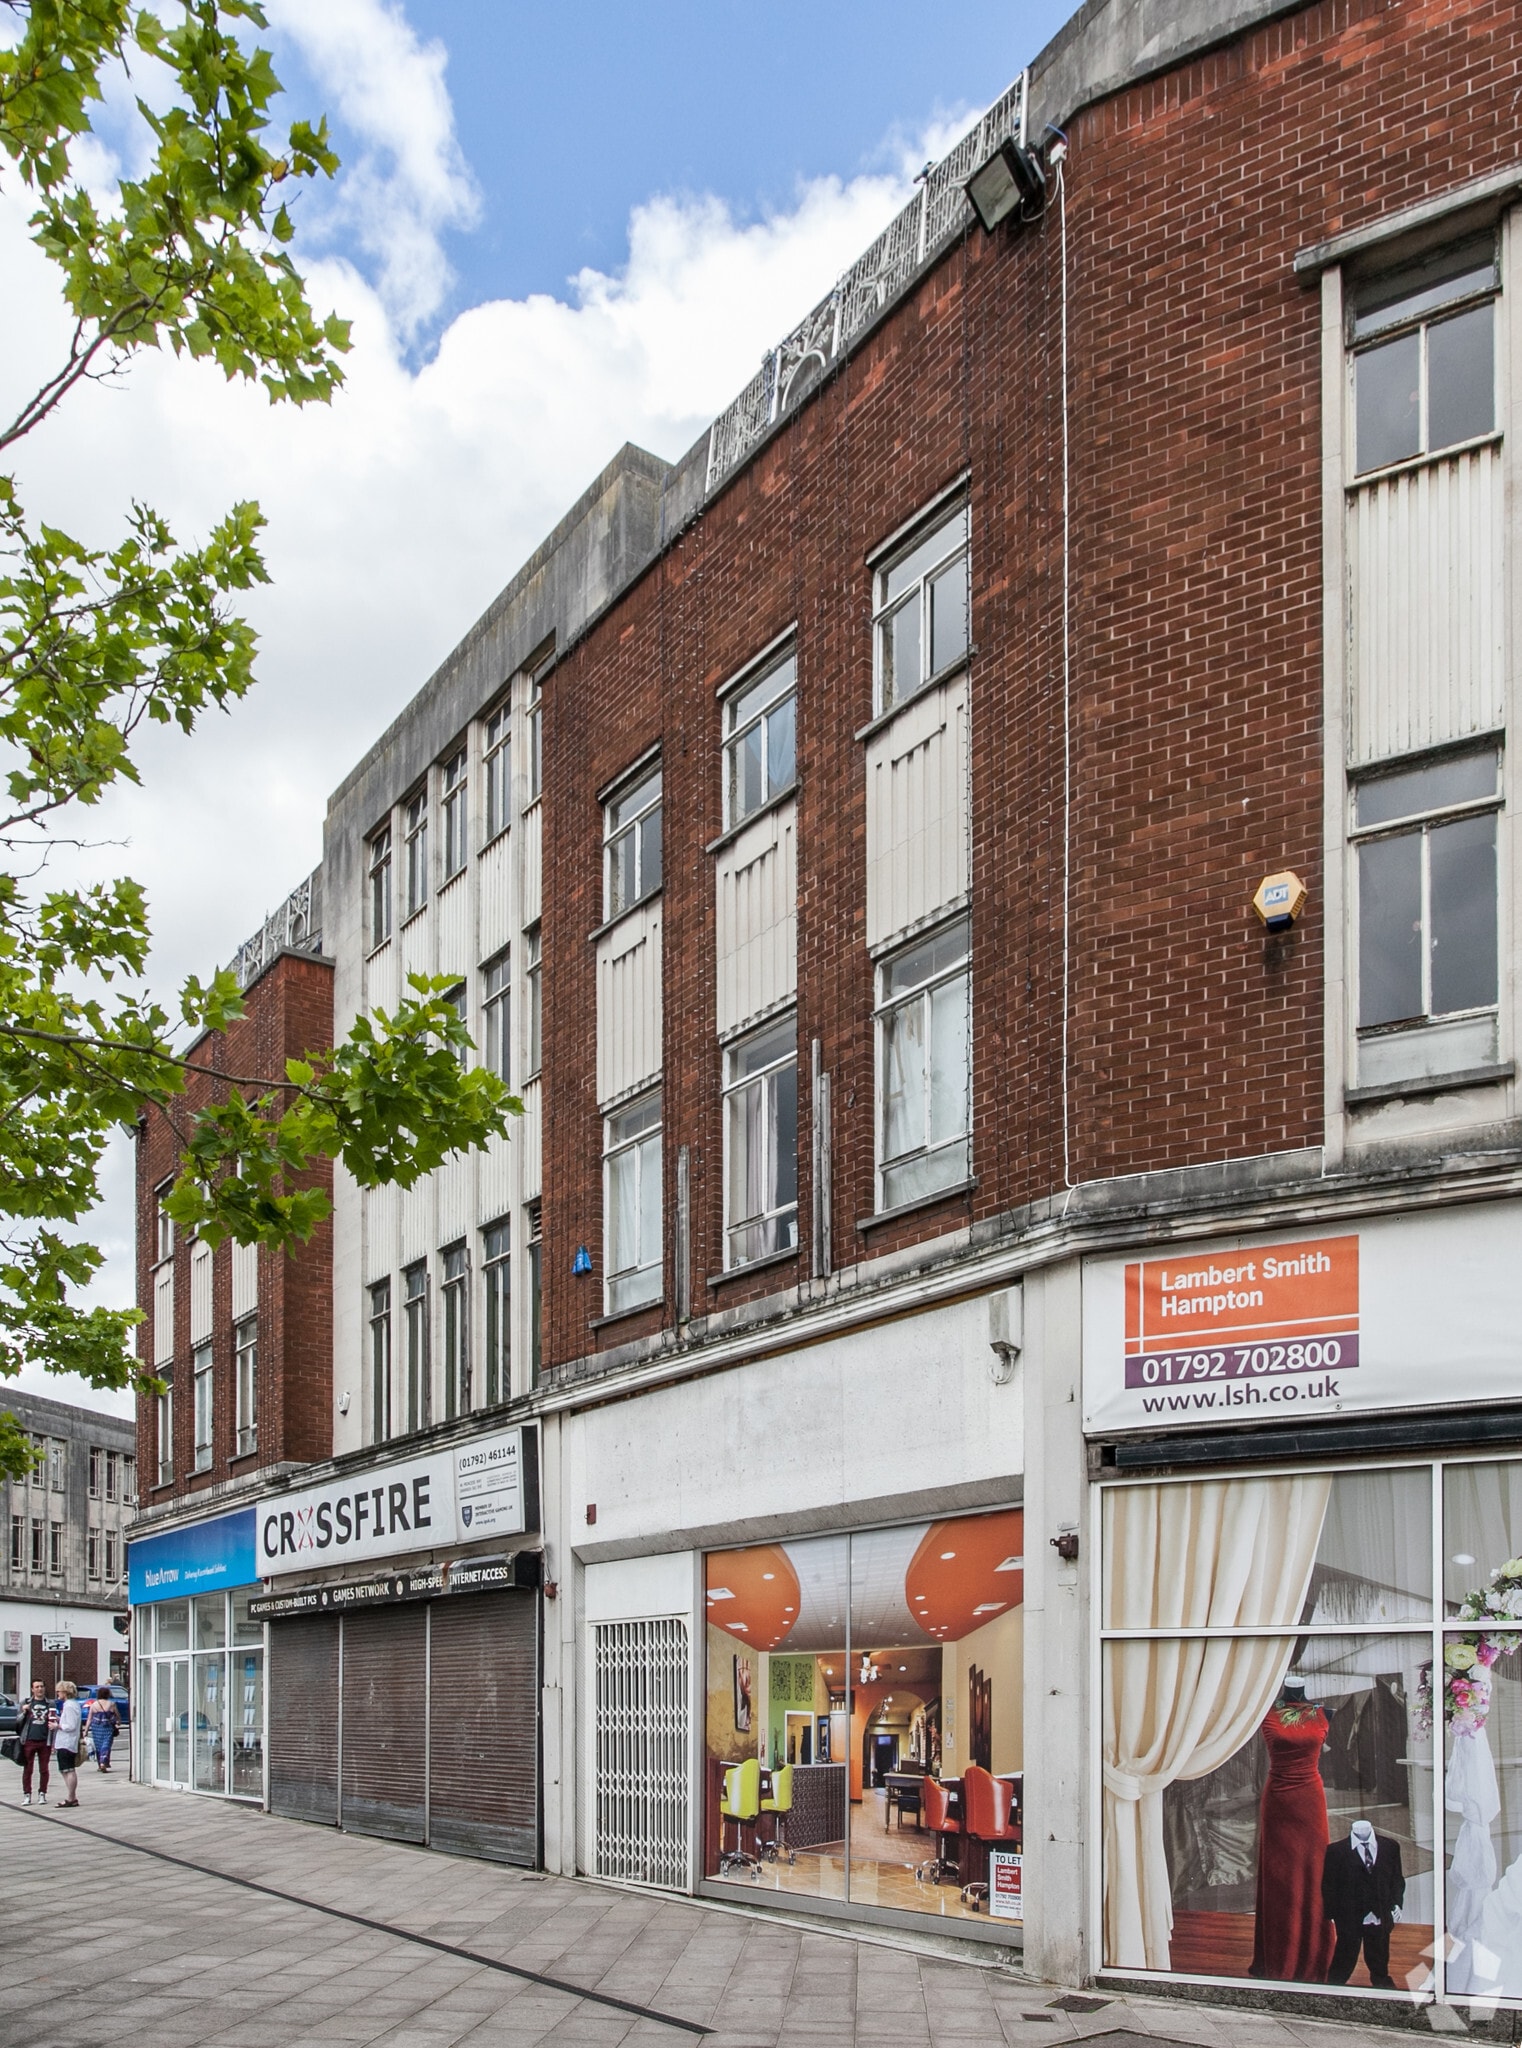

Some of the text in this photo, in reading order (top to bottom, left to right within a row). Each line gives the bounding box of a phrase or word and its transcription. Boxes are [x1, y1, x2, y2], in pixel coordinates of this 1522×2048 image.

[1265, 887, 1288, 903] ADT
[1161, 1251, 1331, 1292] Lambert Smith
[1161, 1289, 1263, 1317] Hampton
[1142, 1340, 1341, 1384] 01792 702800
[1143, 1375, 1340, 1413] www.lsh.co.uk
[459, 1445, 516, 1471] (01792) 461144
[145, 1568, 179, 1587] blueArrow
[449, 1570, 481, 1586] INTERNET
[482, 1567, 508, 1580] ACCESS
[333, 1582, 390, 1602] GAMES NETWORK
[250, 1604, 256, 1613] PC
[256, 1602, 270, 1612] GAMES
[308, 1595, 316, 1606] PCS
[996, 1855, 1021, 1864] TO LET
[998, 1866, 1018, 1875] Lambert
[998, 1874, 1012, 1882] Smith
[997, 1881, 1020, 1890] Hampton
